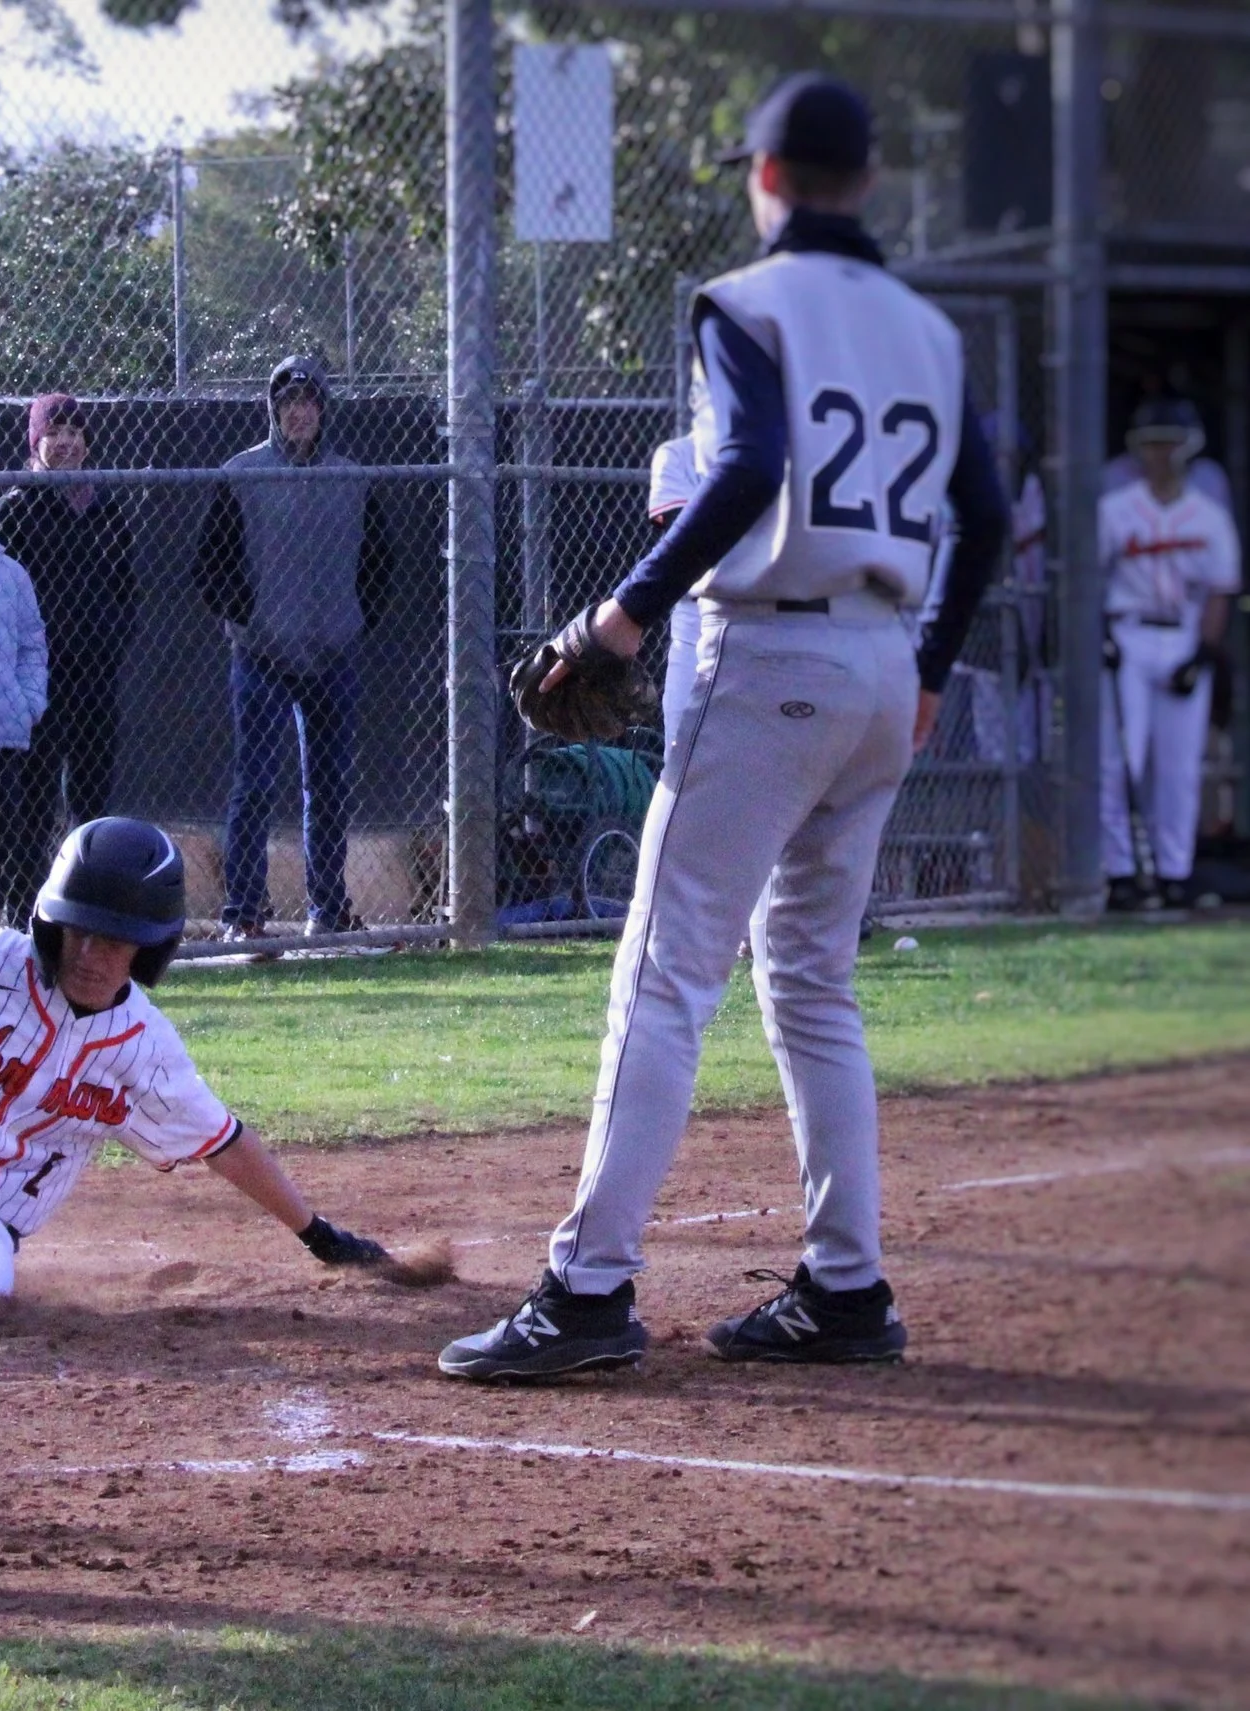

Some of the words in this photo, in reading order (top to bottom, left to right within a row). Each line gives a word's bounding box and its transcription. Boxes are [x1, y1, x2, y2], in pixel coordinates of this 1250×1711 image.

[811, 389, 939, 542] 22
[22, 1152, 66, 1199] 1
[775, 1306, 819, 1340] N
